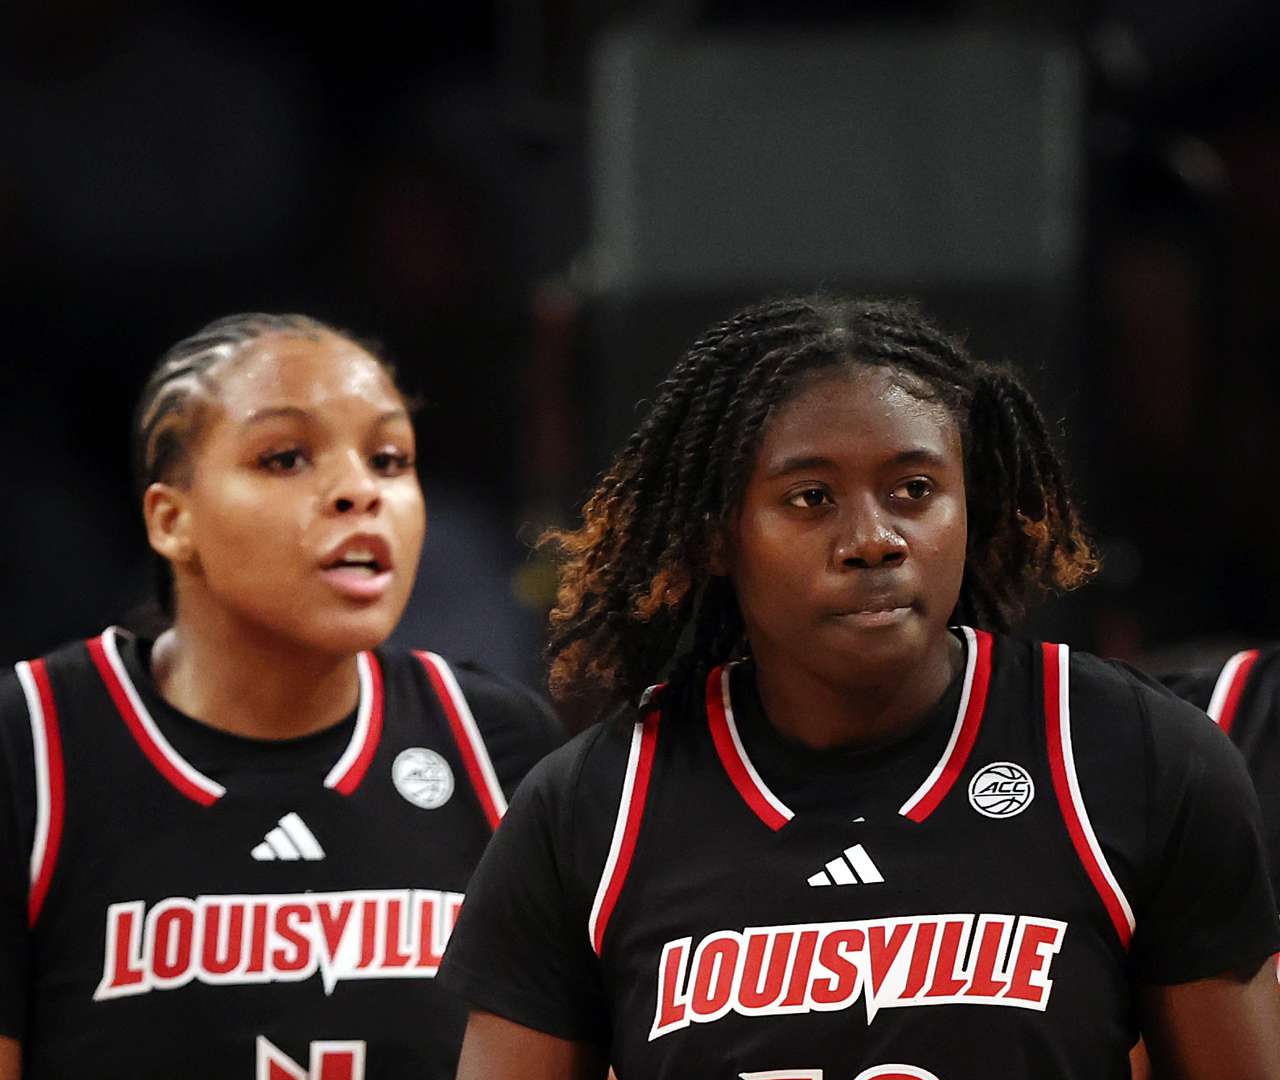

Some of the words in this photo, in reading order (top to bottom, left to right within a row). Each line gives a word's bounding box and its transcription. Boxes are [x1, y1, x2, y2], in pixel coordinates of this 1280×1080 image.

[978, 781, 1029, 793] ACC
[93, 888, 466, 1001] LOUISVILL
[649, 913, 1068, 1041] LOUISVILLE
